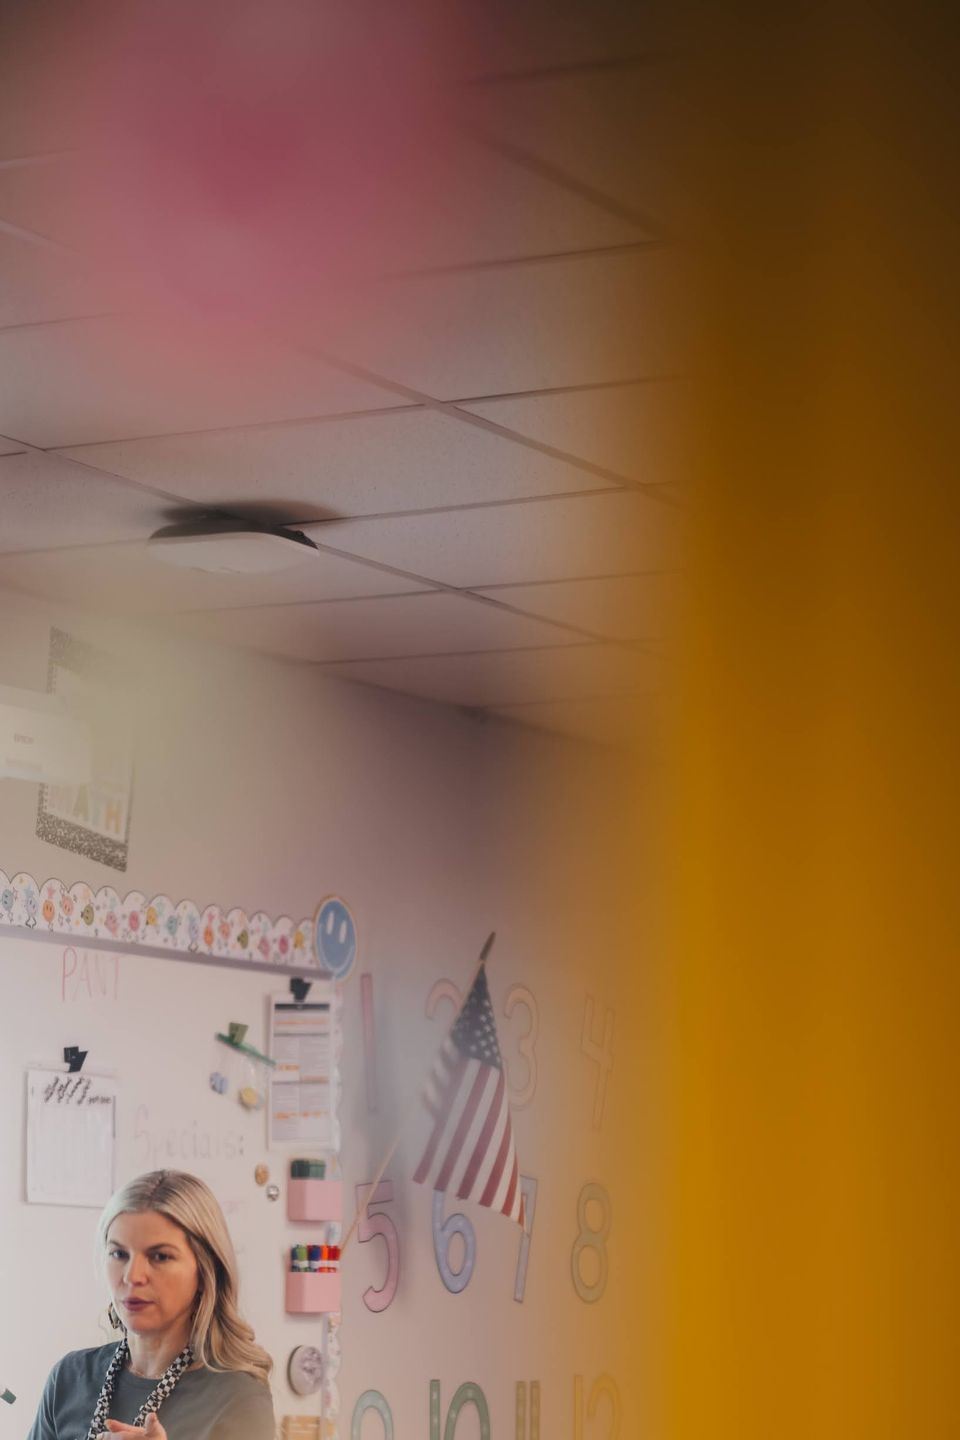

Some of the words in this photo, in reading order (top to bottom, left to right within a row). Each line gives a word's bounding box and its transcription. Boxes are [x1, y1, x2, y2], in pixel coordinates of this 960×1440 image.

[503, 982, 539, 1110] 3
[580, 993, 615, 1132] 4
[355, 1179, 401, 1313] 5
[431, 1190, 477, 1294] 6
[513, 1175, 539, 1304] 7
[571, 1181, 612, 1304] 8
